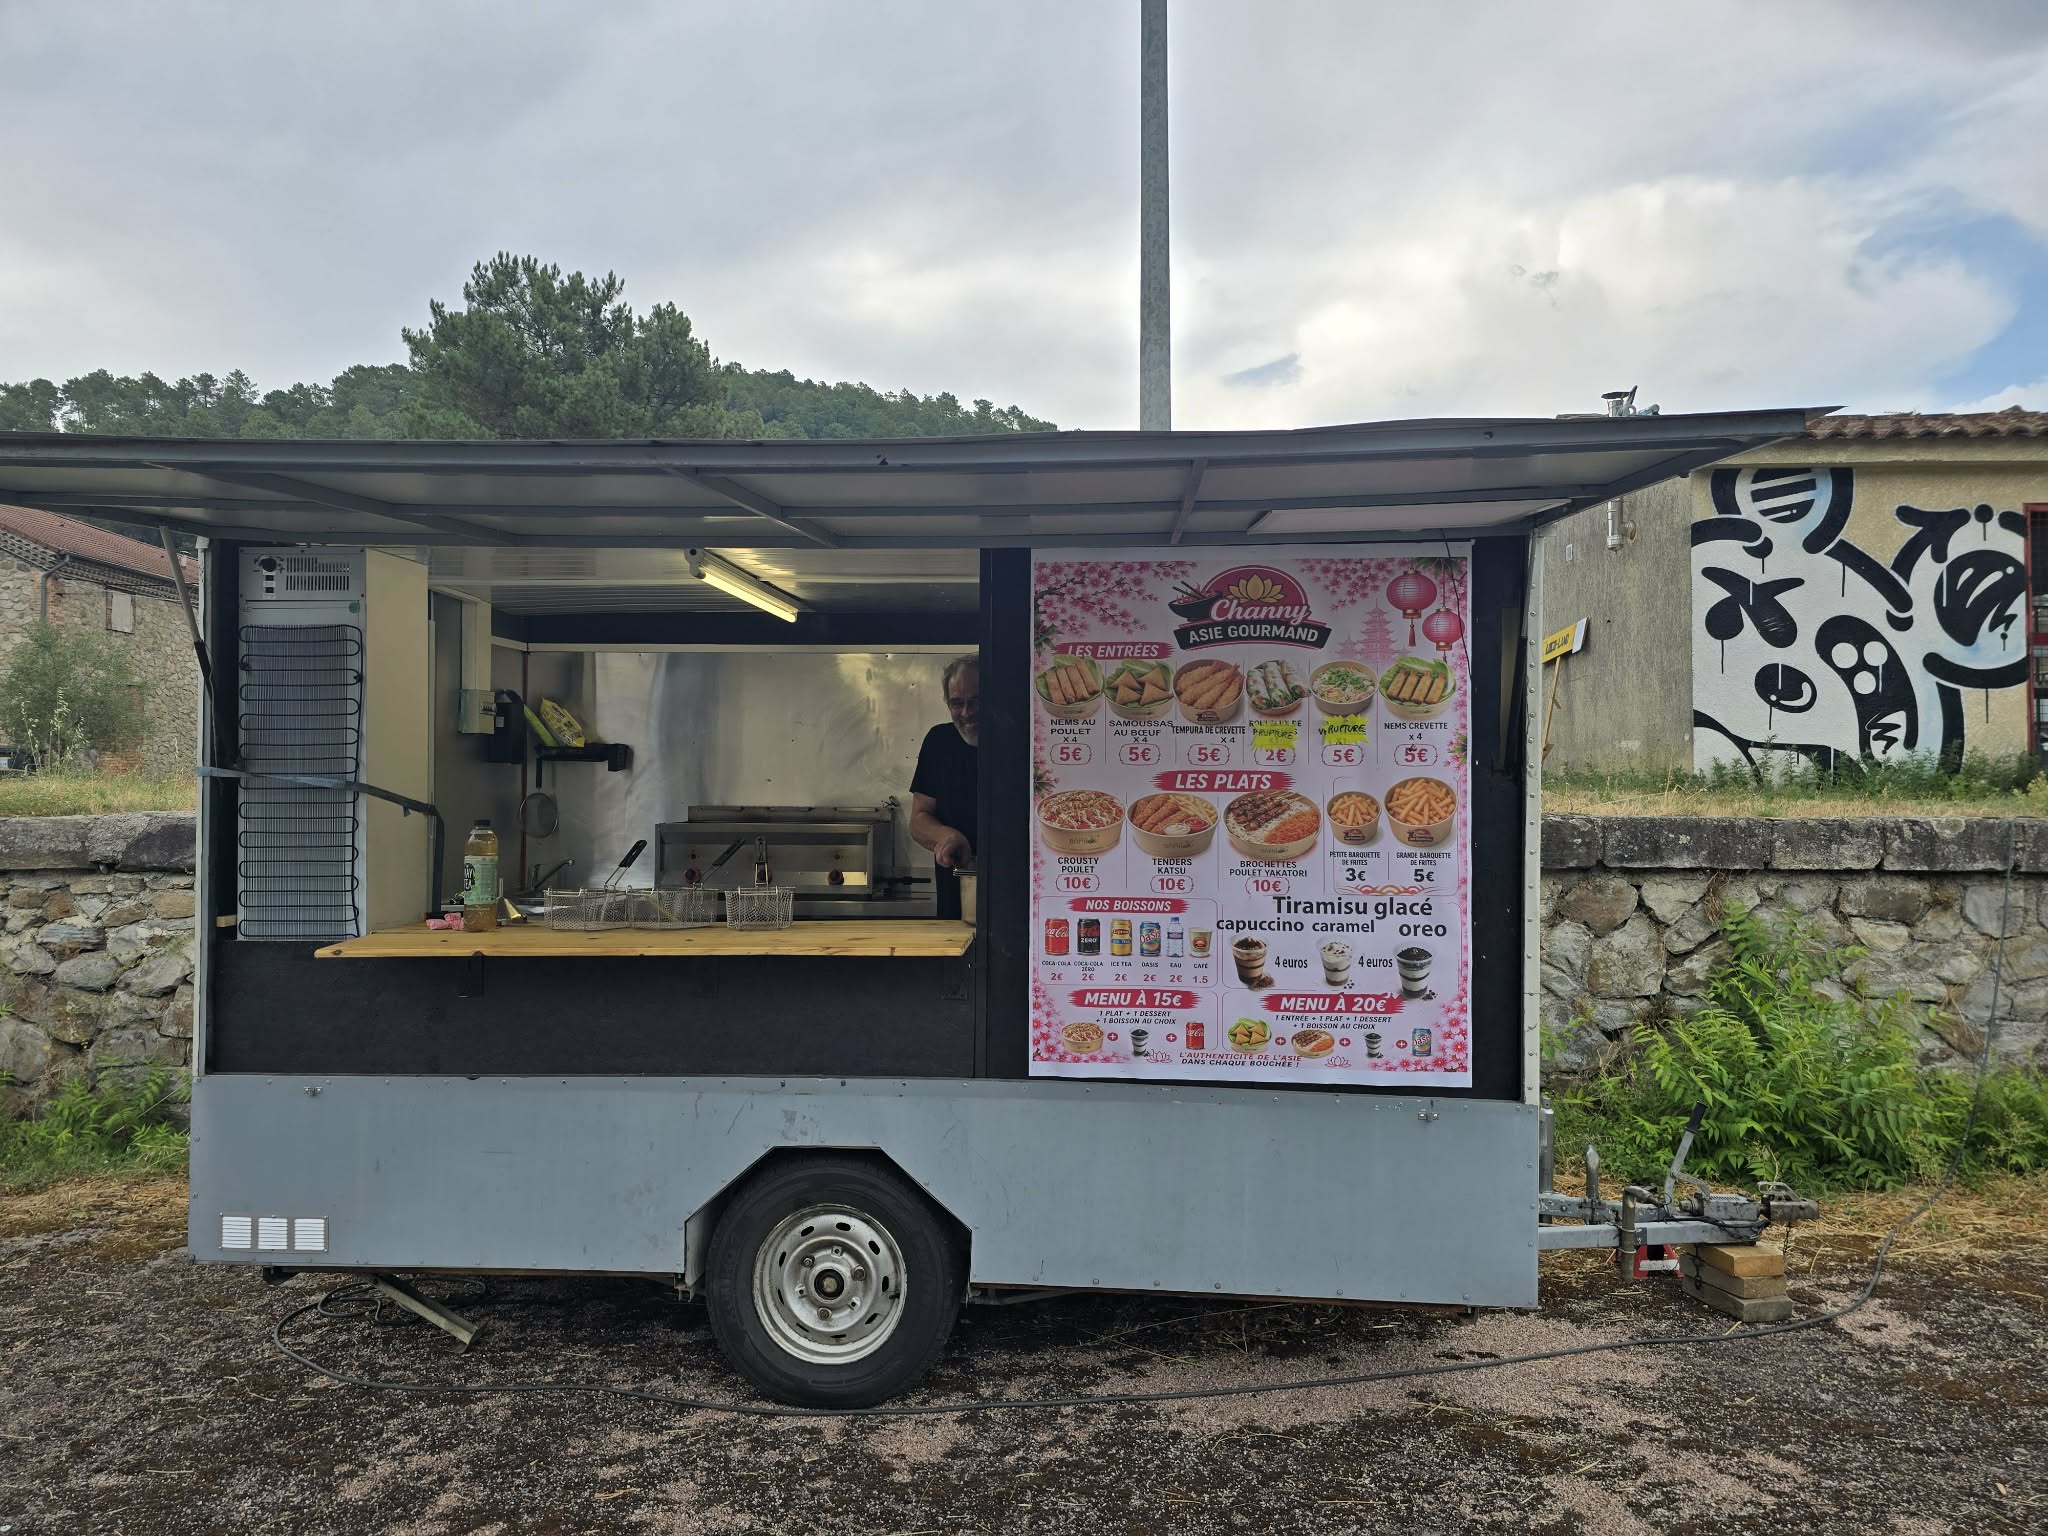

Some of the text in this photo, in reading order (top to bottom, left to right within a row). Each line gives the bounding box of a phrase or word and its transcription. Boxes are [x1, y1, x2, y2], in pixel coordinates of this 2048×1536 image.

[1211, 600, 1308, 625] Channy
[1189, 624, 1318, 644] ASIE GOURMAND
[1068, 642, 1160, 658] LES ENTRÉES
[1172, 726, 1204, 734] TEMPURA
[1205, 726, 1213, 734] DE
[1215, 726, 1245, 734] CREVETTE
[1258, 729, 1294, 739] RUPTURE
[1328, 724, 1366, 734] RUPTURE
[1060, 746, 1082, 762] 5€
[1128, 746, 1152, 762] 5€
[1198, 746, 1220, 762] 5€
[1266, 748, 1286, 762] 2€
[1332, 748, 1354, 762] 5€
[1404, 748, 1428, 762] 5€
[1175, 774, 1272, 790] LES PLATS
[1058, 857, 1099, 865] CROUSTY
[1240, 860, 1297, 869] BROCHETTES
[1345, 868, 1366, 881] 3€
[1414, 869, 1434, 882] 5€
[1064, 876, 1091, 889] 10€
[1158, 877, 1186, 890] 10€
[1253, 880, 1281, 892] 10€
[1086, 900, 1171, 911] NOS BOISSONS
[1273, 896, 1433, 920] Tiramisu glacé
[1216, 917, 1447, 937] capuccino caramel oreo
[1274, 956, 1308, 969] 4 euros
[1358, 956, 1393, 968] 4 euros
[1084, 990, 1182, 1006] MENU À 15€
[1280, 994, 1387, 1012] MENU À 20€
